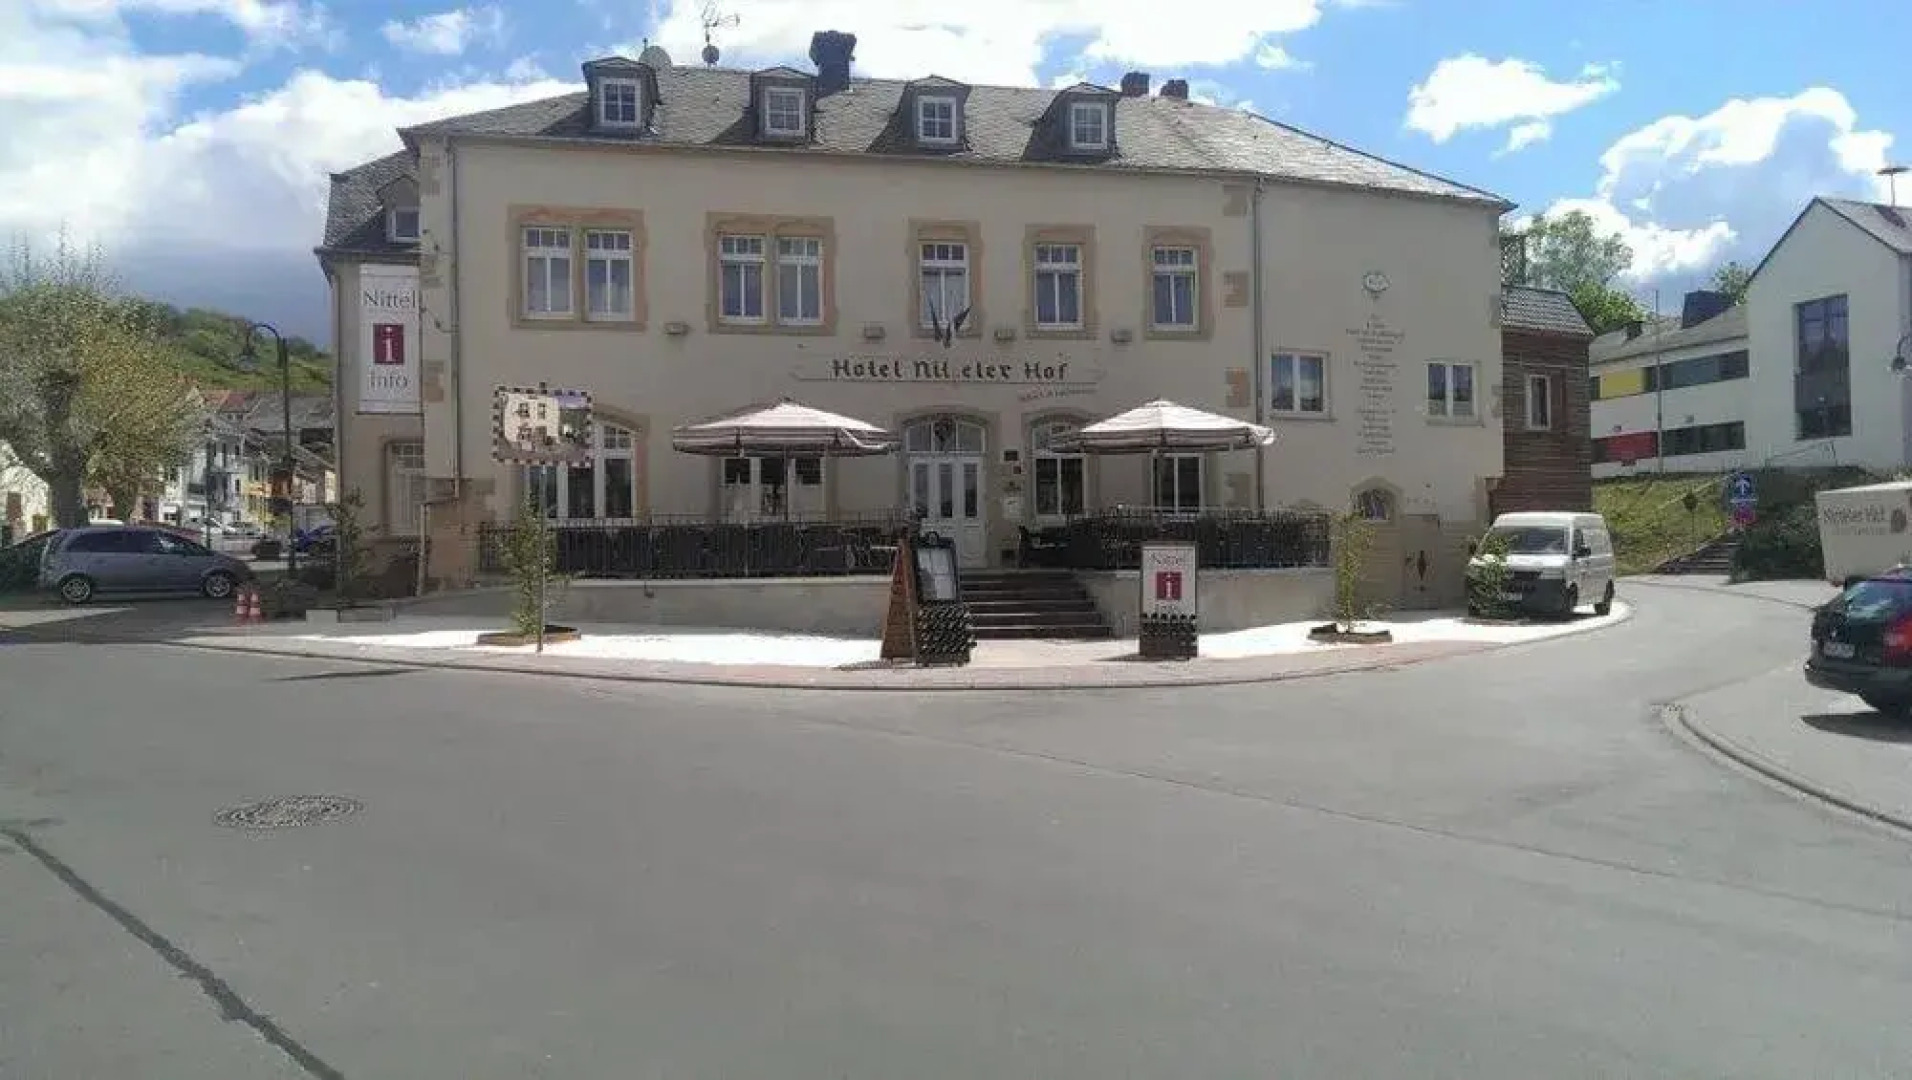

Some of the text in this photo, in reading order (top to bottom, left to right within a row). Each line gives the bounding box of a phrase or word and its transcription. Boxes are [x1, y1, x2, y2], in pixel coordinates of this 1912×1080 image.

[363, 289, 416, 308] Nittel
[832, 359, 1068, 380] Hotel Niteler Hof
